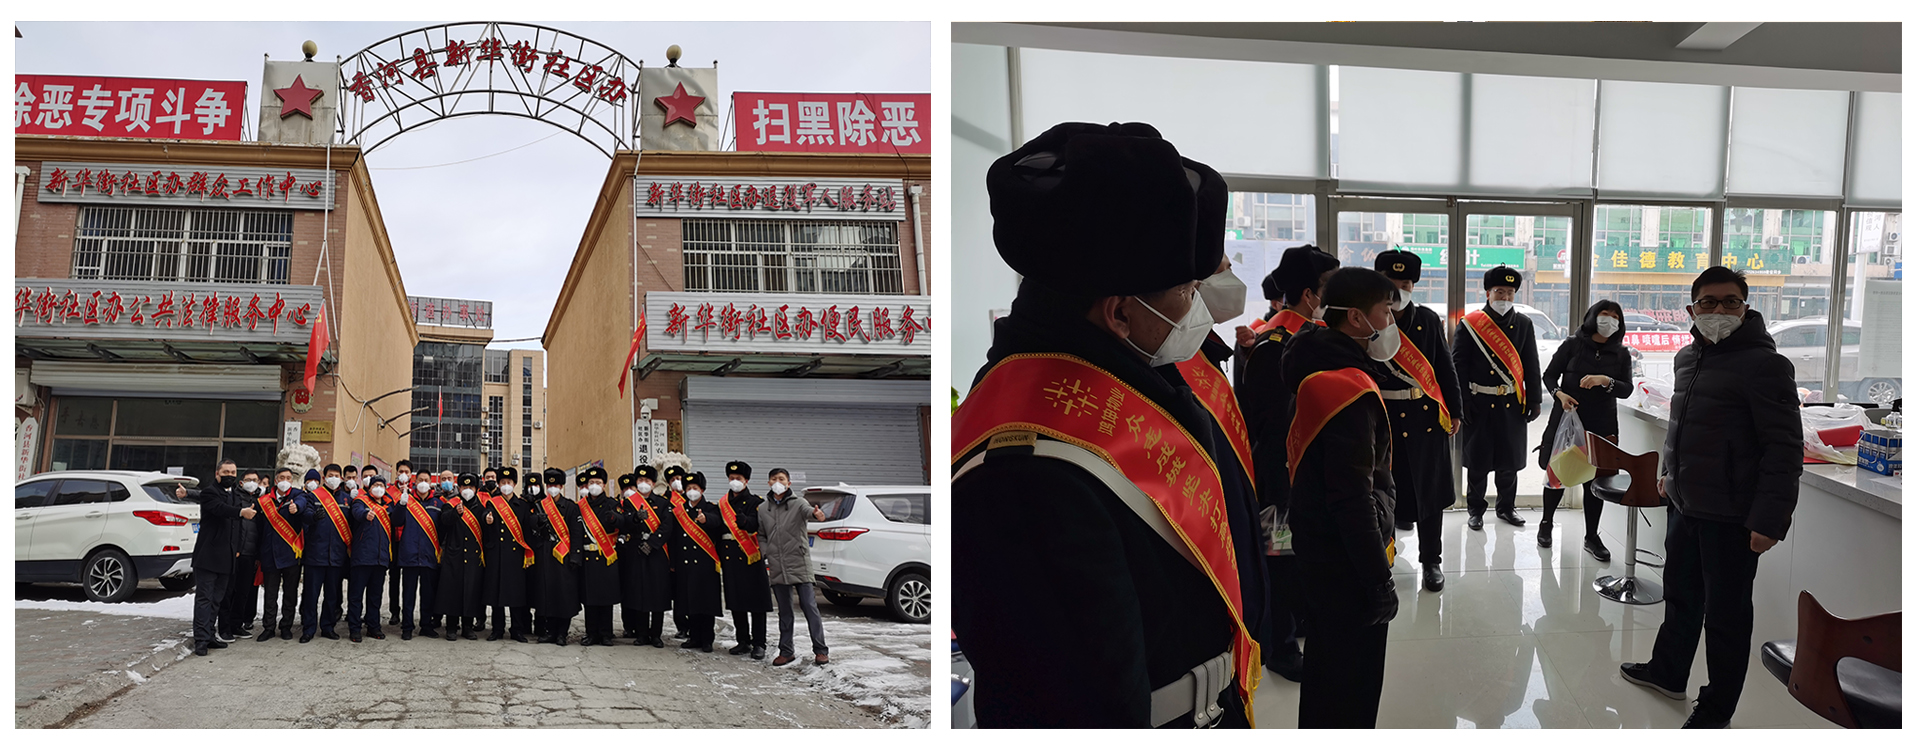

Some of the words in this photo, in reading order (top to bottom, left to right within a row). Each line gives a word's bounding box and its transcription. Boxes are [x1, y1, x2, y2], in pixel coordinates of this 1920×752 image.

[349, 37, 627, 103] 香河县新华街社区办
[753, 99, 921, 147] 扫黑除恶
[45, 167, 322, 203] 新华街社区办群众工作中心
[646, 181, 897, 213] 新华街社区办退役军人服务站
